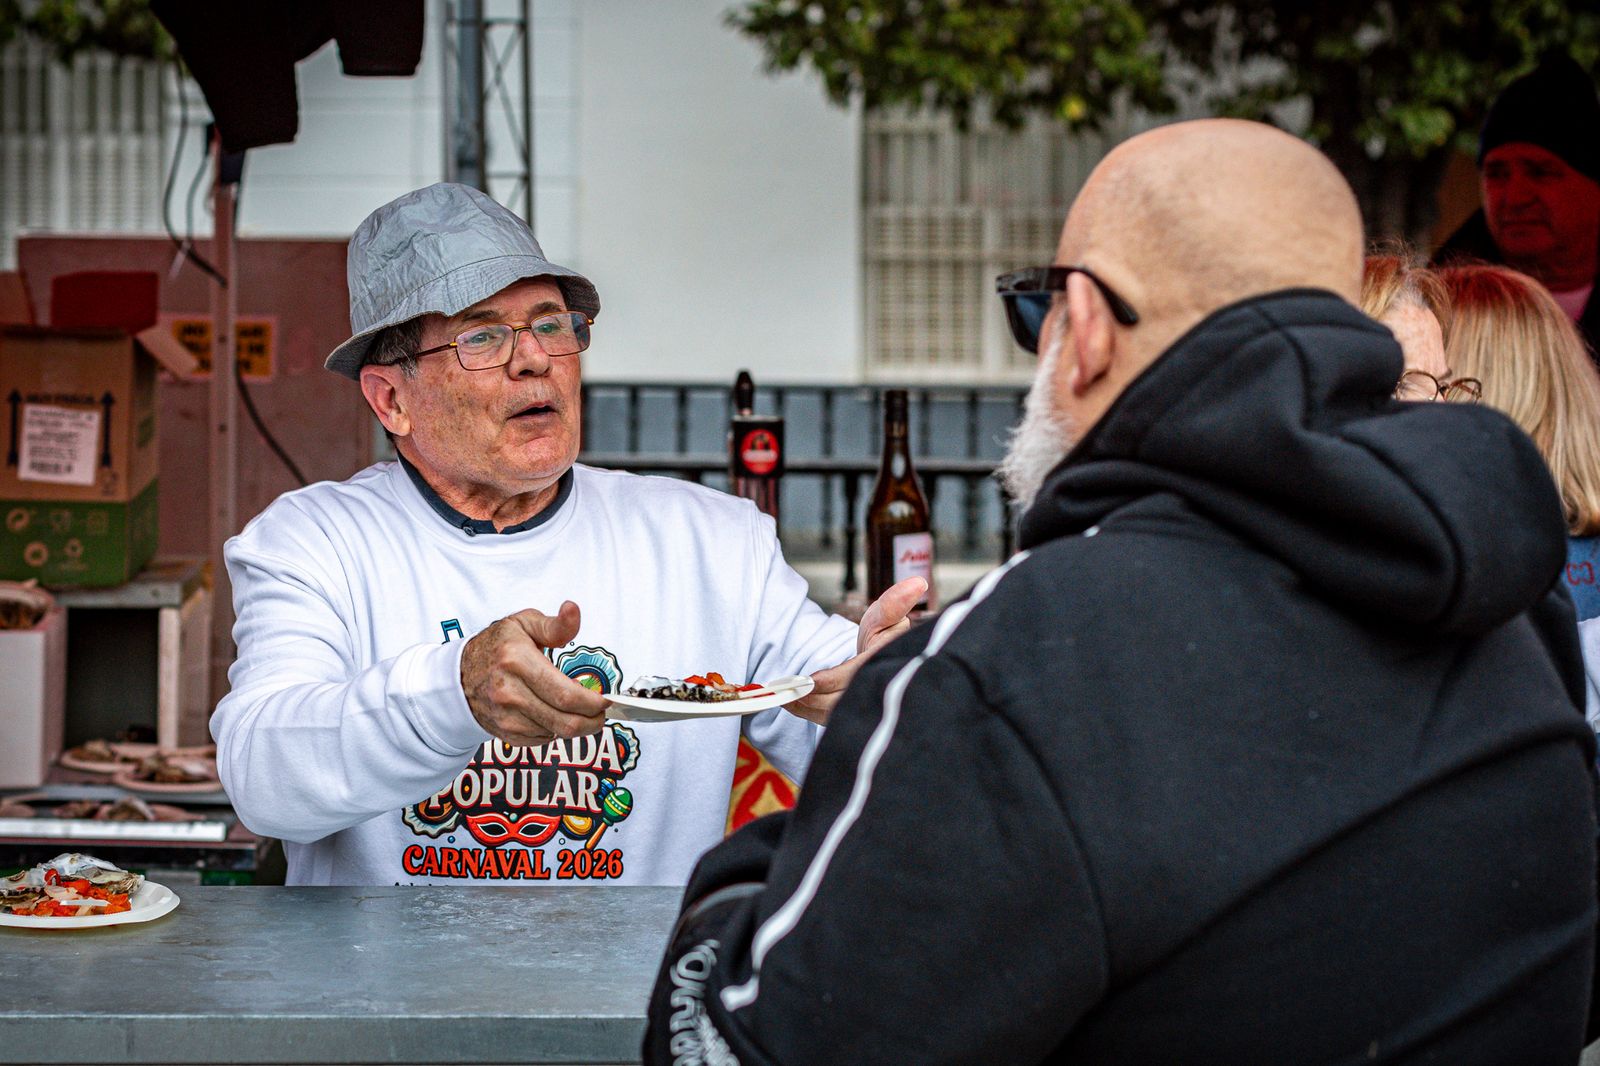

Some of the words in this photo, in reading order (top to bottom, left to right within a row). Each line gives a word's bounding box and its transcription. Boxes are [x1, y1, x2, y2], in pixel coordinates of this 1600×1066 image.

[469, 727, 623, 773] IONADA
[402, 844, 550, 879] CARNAVAL
[556, 848, 624, 880] 2026
